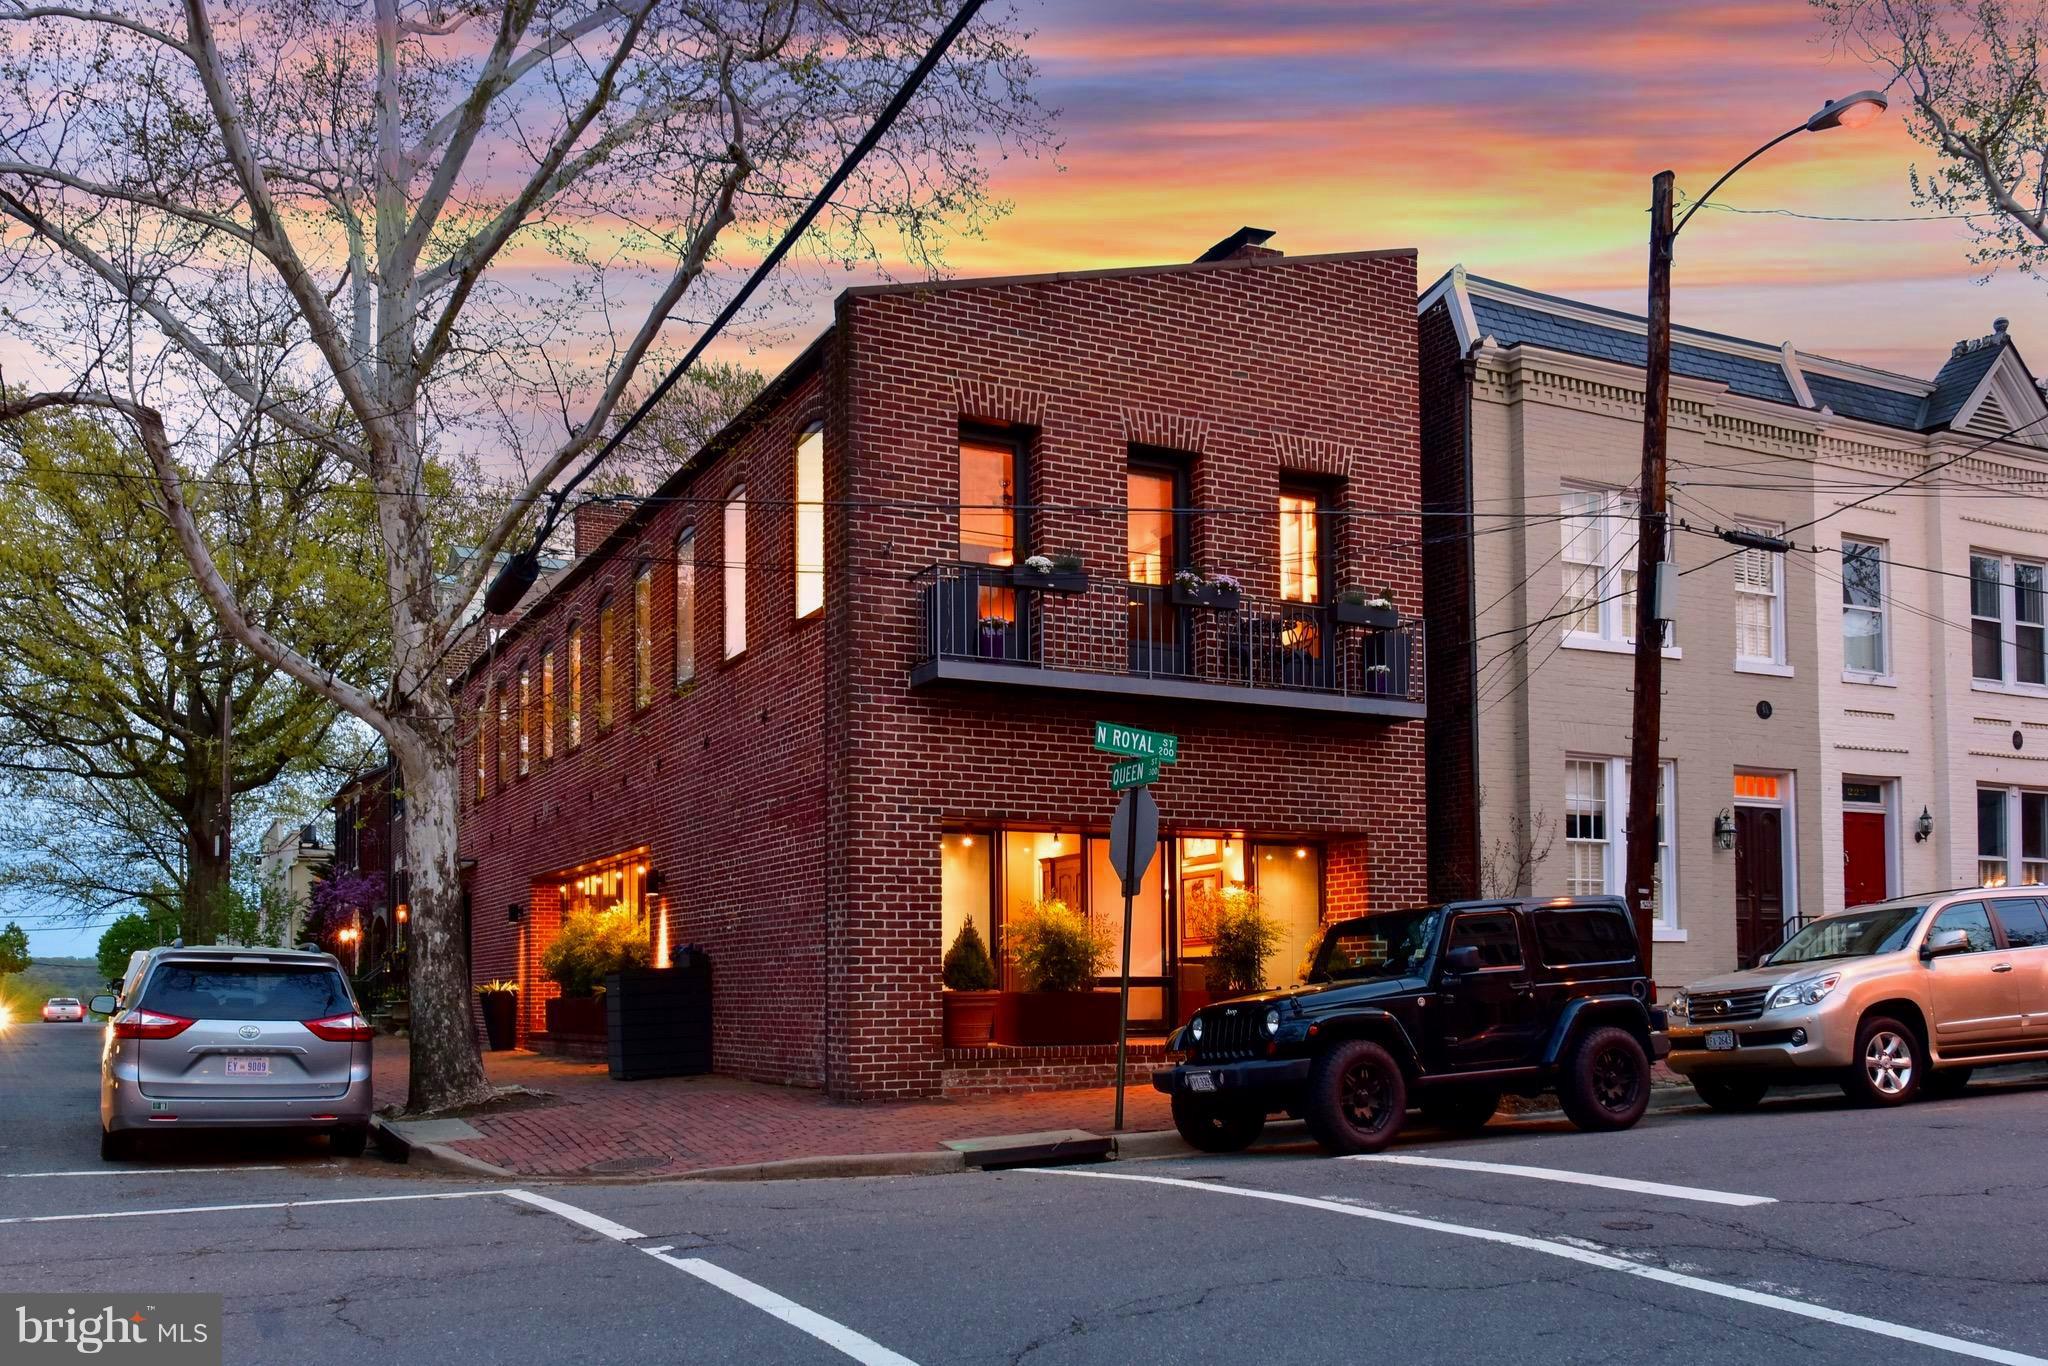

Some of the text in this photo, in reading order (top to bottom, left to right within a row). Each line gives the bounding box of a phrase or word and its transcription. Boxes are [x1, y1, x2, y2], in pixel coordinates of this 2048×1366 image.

[1097, 726, 1174, 754] N ROYAL ST
[1158, 746, 1174, 757] 200
[1113, 757, 1158, 786] QUEEN ST
[227, 1061, 238, 1072] EY
